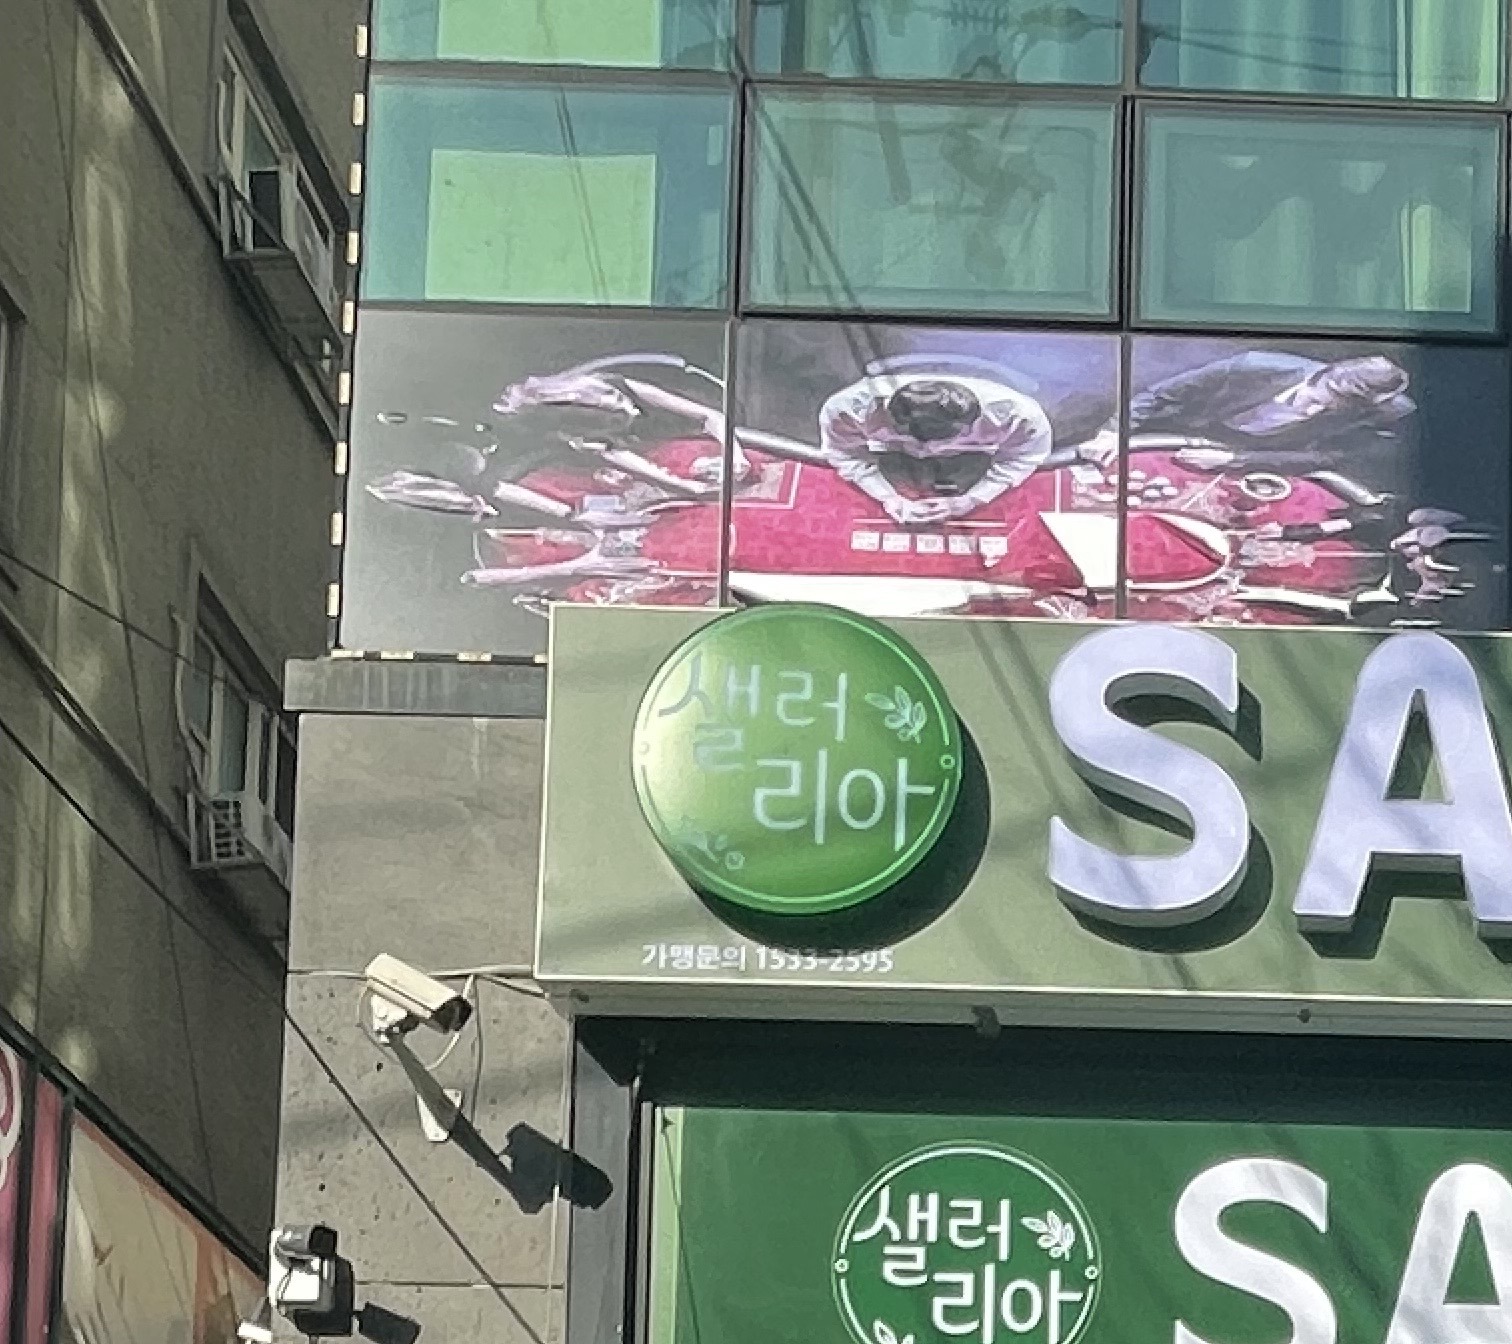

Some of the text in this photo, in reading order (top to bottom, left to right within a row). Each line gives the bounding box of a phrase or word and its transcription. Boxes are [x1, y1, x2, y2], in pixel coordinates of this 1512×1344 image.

[657, 652, 848, 777] 샐러
[752, 748, 936, 852] 리아
[641, 943, 894, 972] 가맹문의 1533-2595
[854, 1185, 1009, 1287] 샐러
